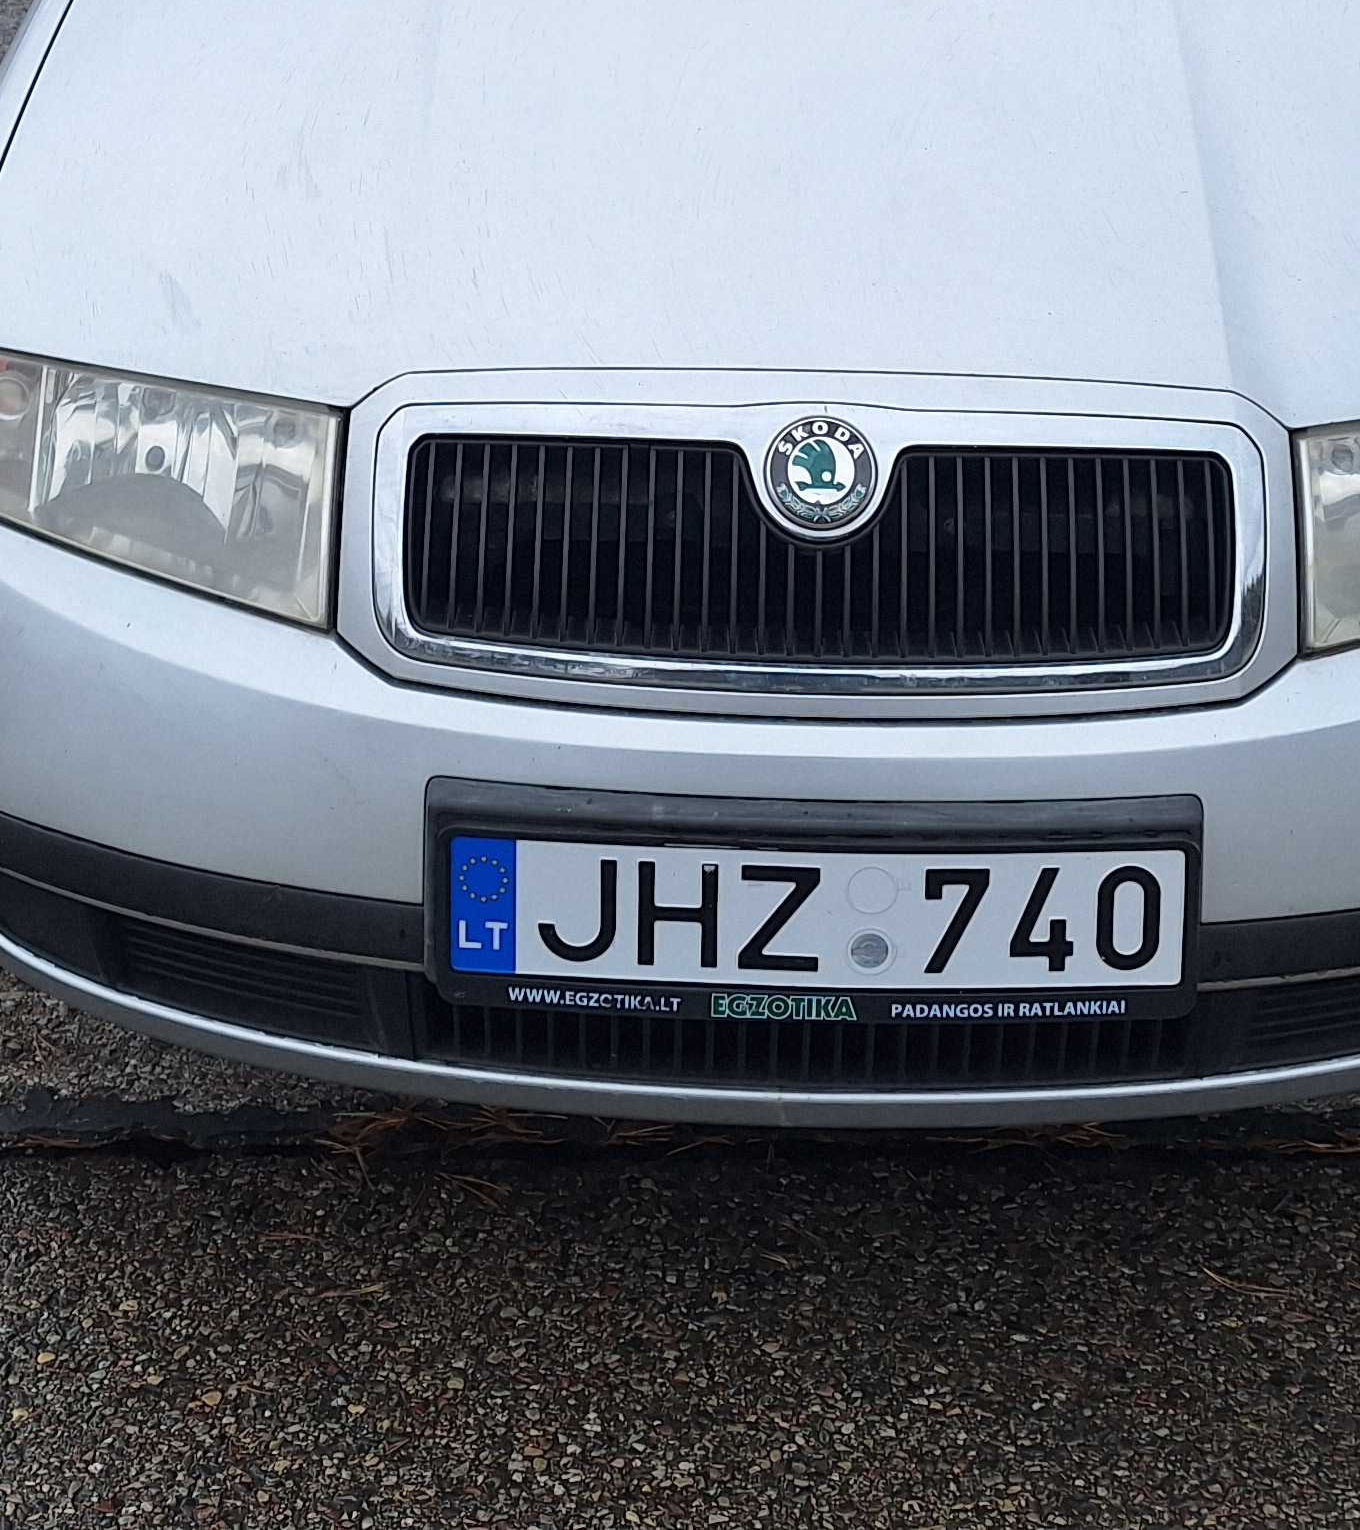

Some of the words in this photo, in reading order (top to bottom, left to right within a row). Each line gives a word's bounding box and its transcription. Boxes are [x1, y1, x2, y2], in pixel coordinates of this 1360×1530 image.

[538, 858, 822, 972] JHZ
[923, 864, 1162, 974] 740
[458, 919, 509, 951] LT
[507, 986, 682, 1012] WWW.EGZOTIKA.LT
[711, 992, 857, 1021] EGZOTIKA
[891, 1003, 994, 1018] PADANGOS
[997, 1002, 1015, 1017] IR
[1018, 999, 1127, 1017] RATLANKIAI
